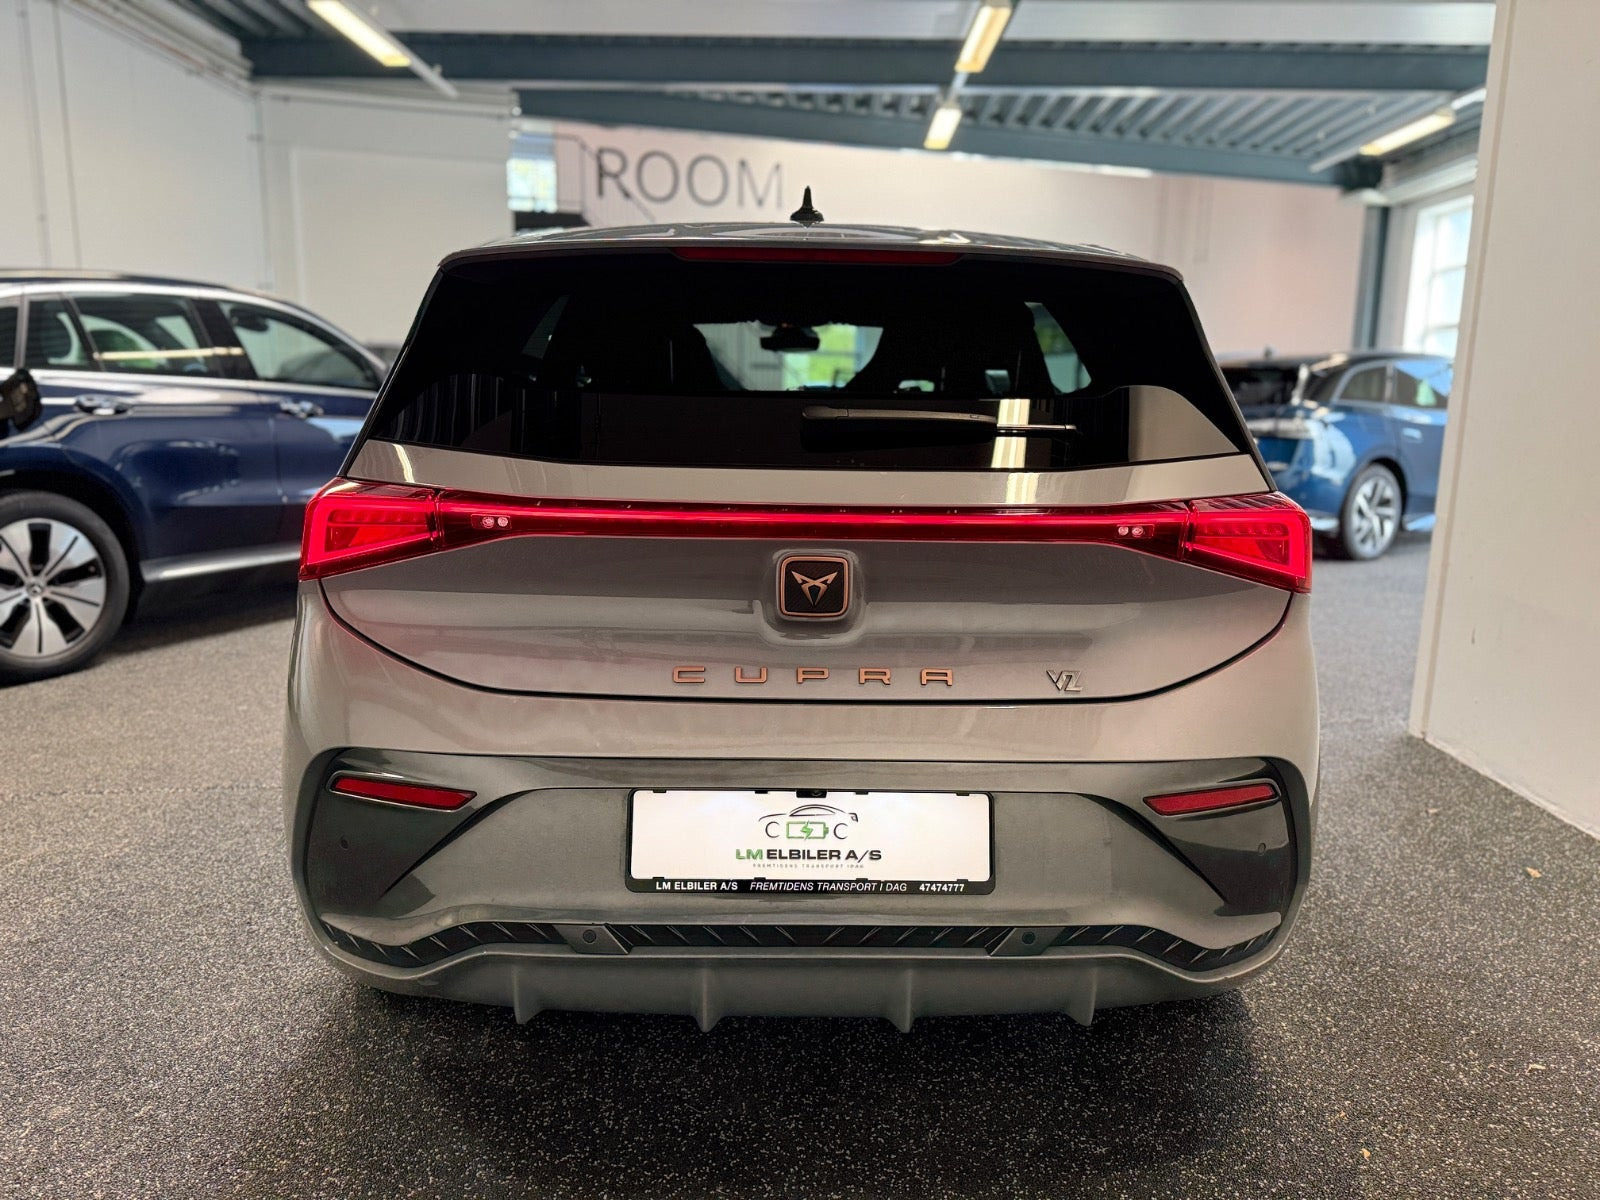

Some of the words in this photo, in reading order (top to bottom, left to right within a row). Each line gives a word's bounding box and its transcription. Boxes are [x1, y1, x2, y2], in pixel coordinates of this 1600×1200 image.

[596, 147, 783, 208] ROOM
[672, 666, 953, 686] CUPRA
[1046, 669, 1084, 692] VZ
[736, 849, 763, 860] LM
[767, 849, 841, 860] ELBILER
[845, 850, 882, 863] A/S
[656, 882, 671, 890] LM
[674, 882, 717, 890] ELBILER
[720, 882, 738, 890] A/S
[750, 882, 814, 891] FREMTIDENS
[817, 882, 877, 891] TRANSPORT
[886, 883, 907, 891] DAG
[919, 883, 965, 892] 47474777
